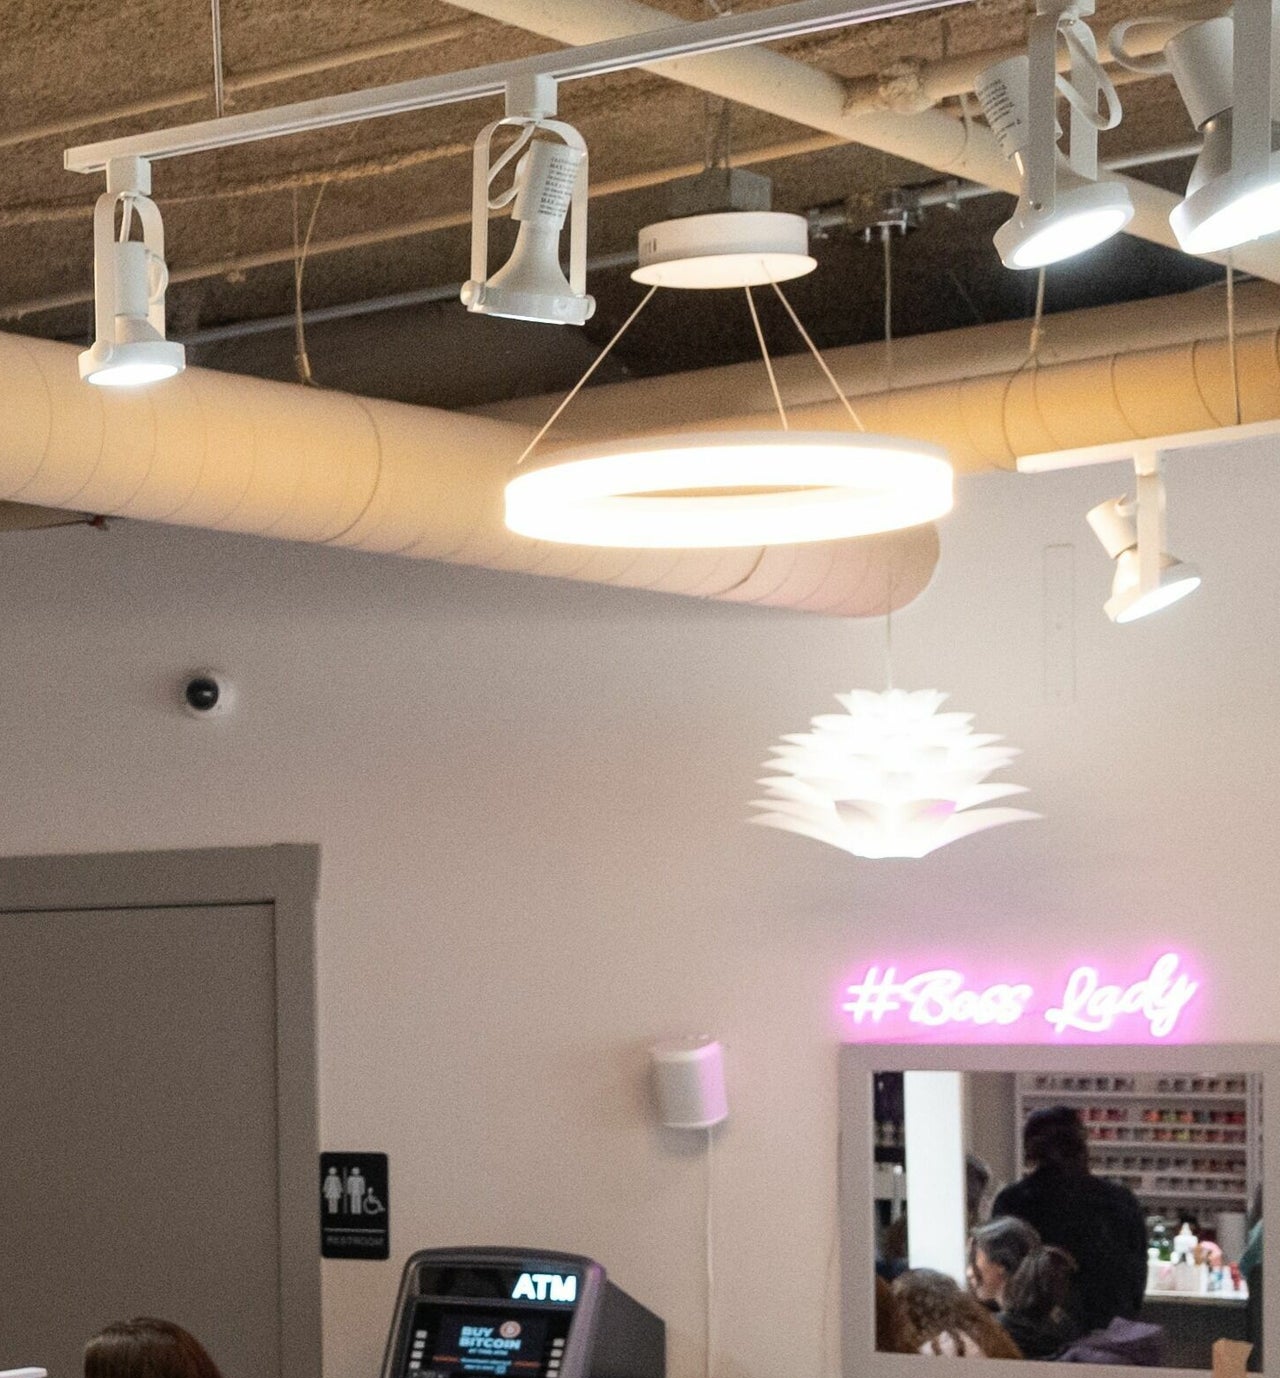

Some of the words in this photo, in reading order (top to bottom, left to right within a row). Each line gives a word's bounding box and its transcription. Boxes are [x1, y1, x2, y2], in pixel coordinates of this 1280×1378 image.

[842, 966, 1034, 1026] #Boss
[1044, 952, 1199, 1038] Lady
[512, 1273, 577, 1302] ATM
[462, 1326, 495, 1338] BUY
[459, 1337, 522, 1350] BITCOIN
